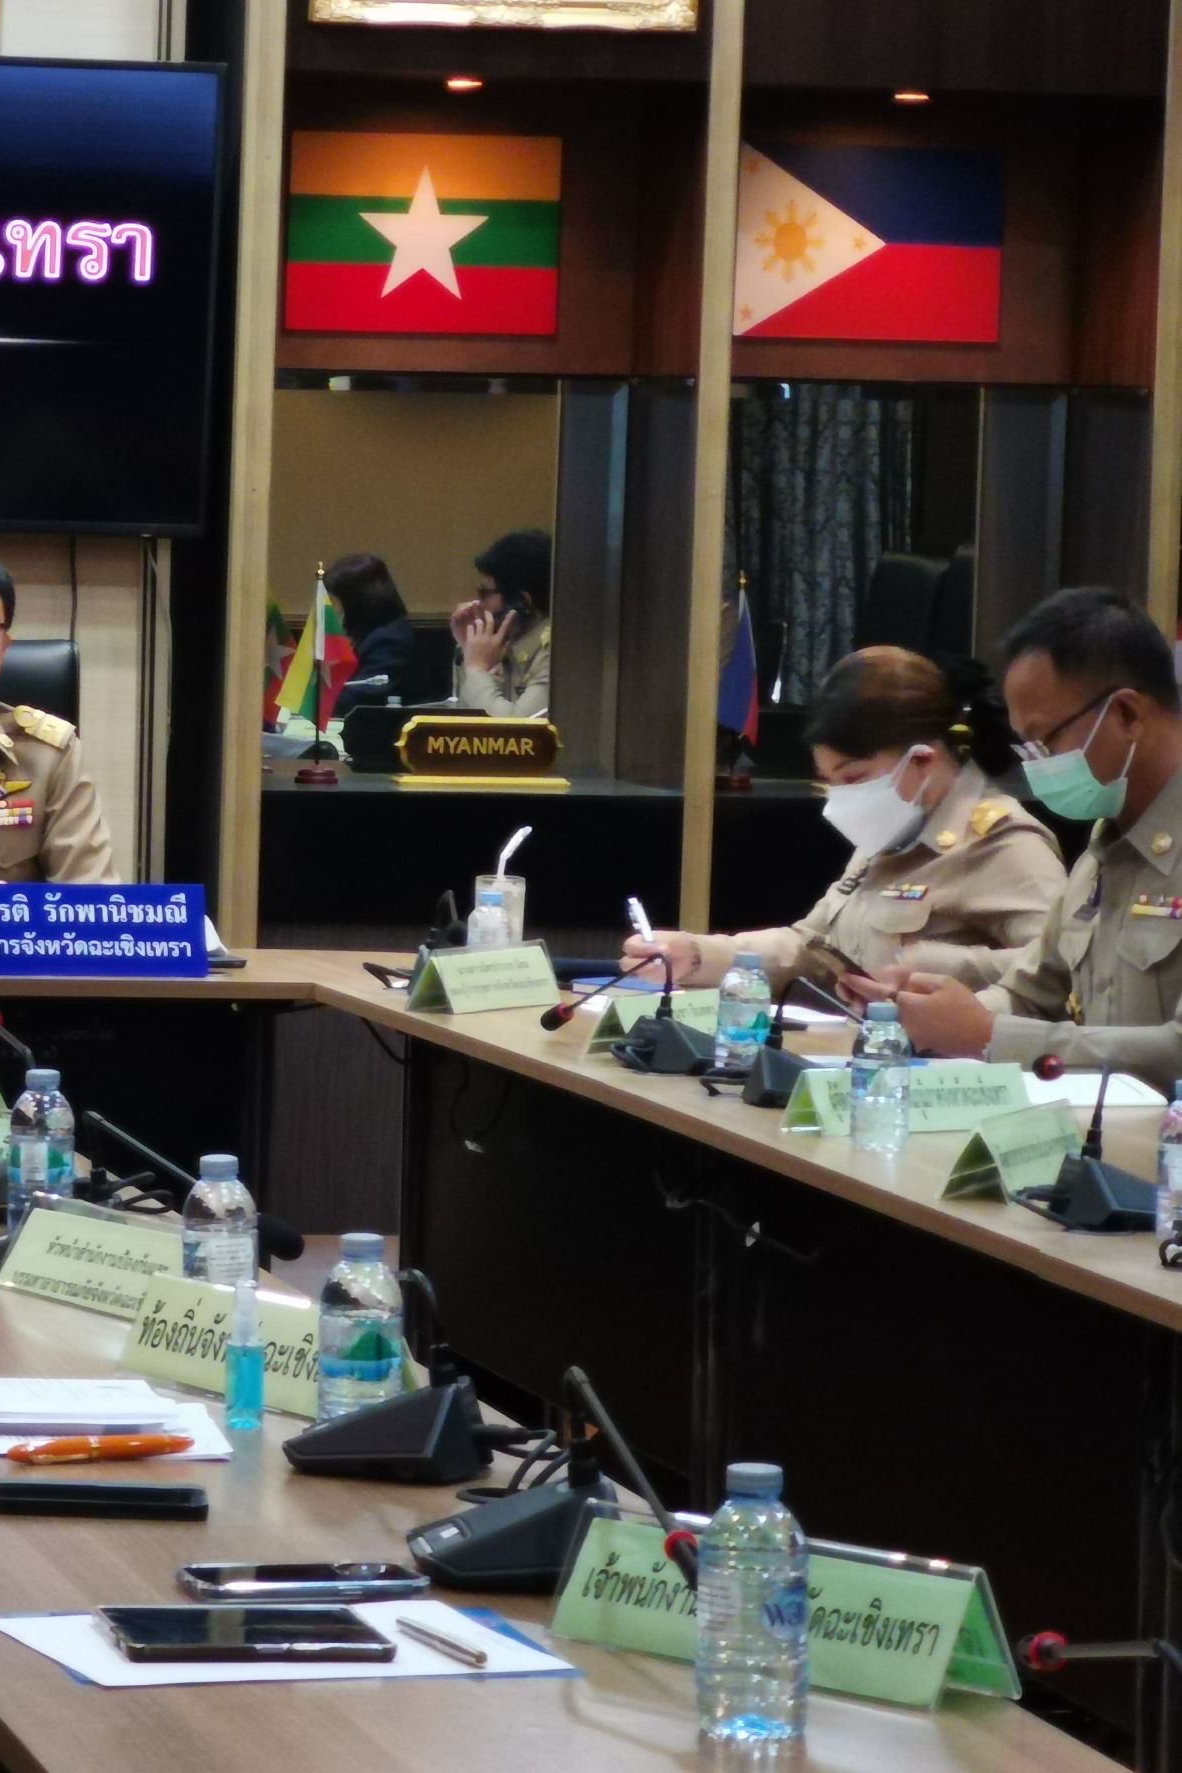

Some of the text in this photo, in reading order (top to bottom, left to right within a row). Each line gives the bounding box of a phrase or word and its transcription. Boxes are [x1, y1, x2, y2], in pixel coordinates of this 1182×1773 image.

[427, 736, 535, 756] MYANMAR
[43, 892, 188, 924] รักพานิชมณี
